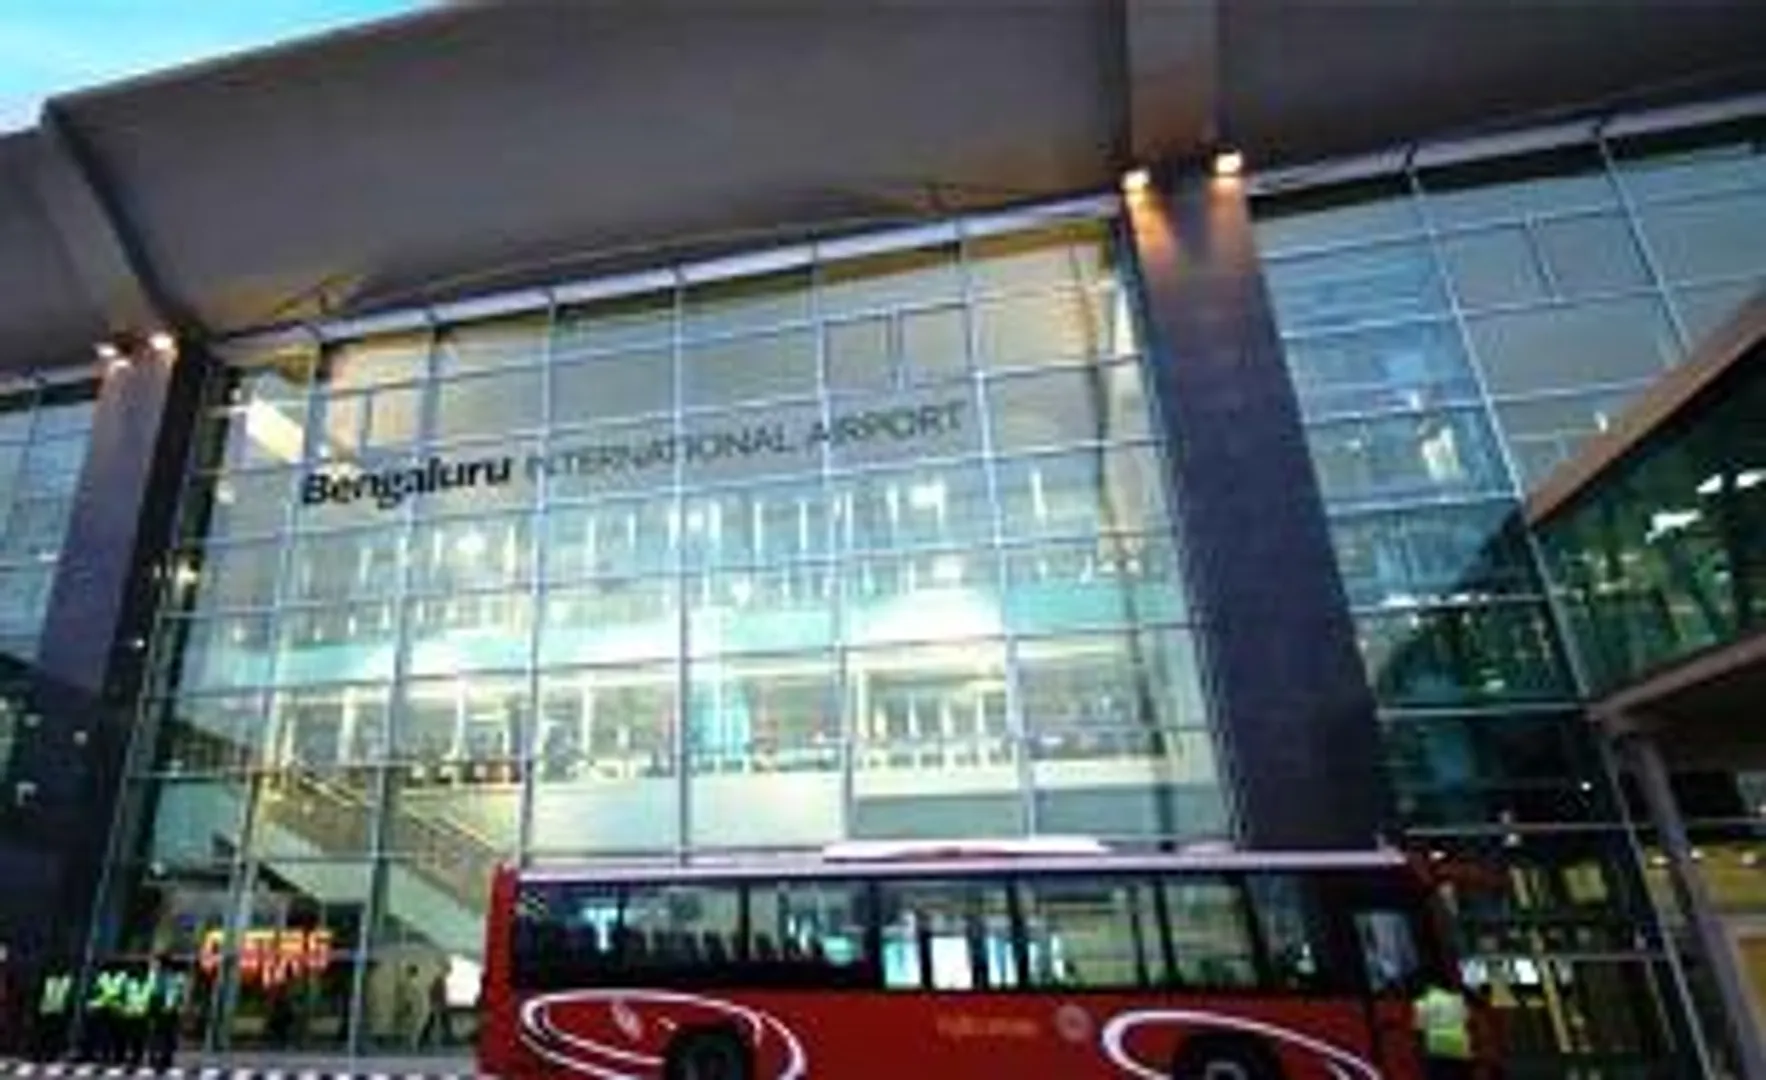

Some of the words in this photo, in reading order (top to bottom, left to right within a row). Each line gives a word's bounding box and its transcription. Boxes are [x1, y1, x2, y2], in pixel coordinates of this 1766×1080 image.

[302, 456, 513, 510] Bengaluru
[525, 424, 796, 480] INTERNATIONAL
[806, 401, 966, 455] AIRPORT
